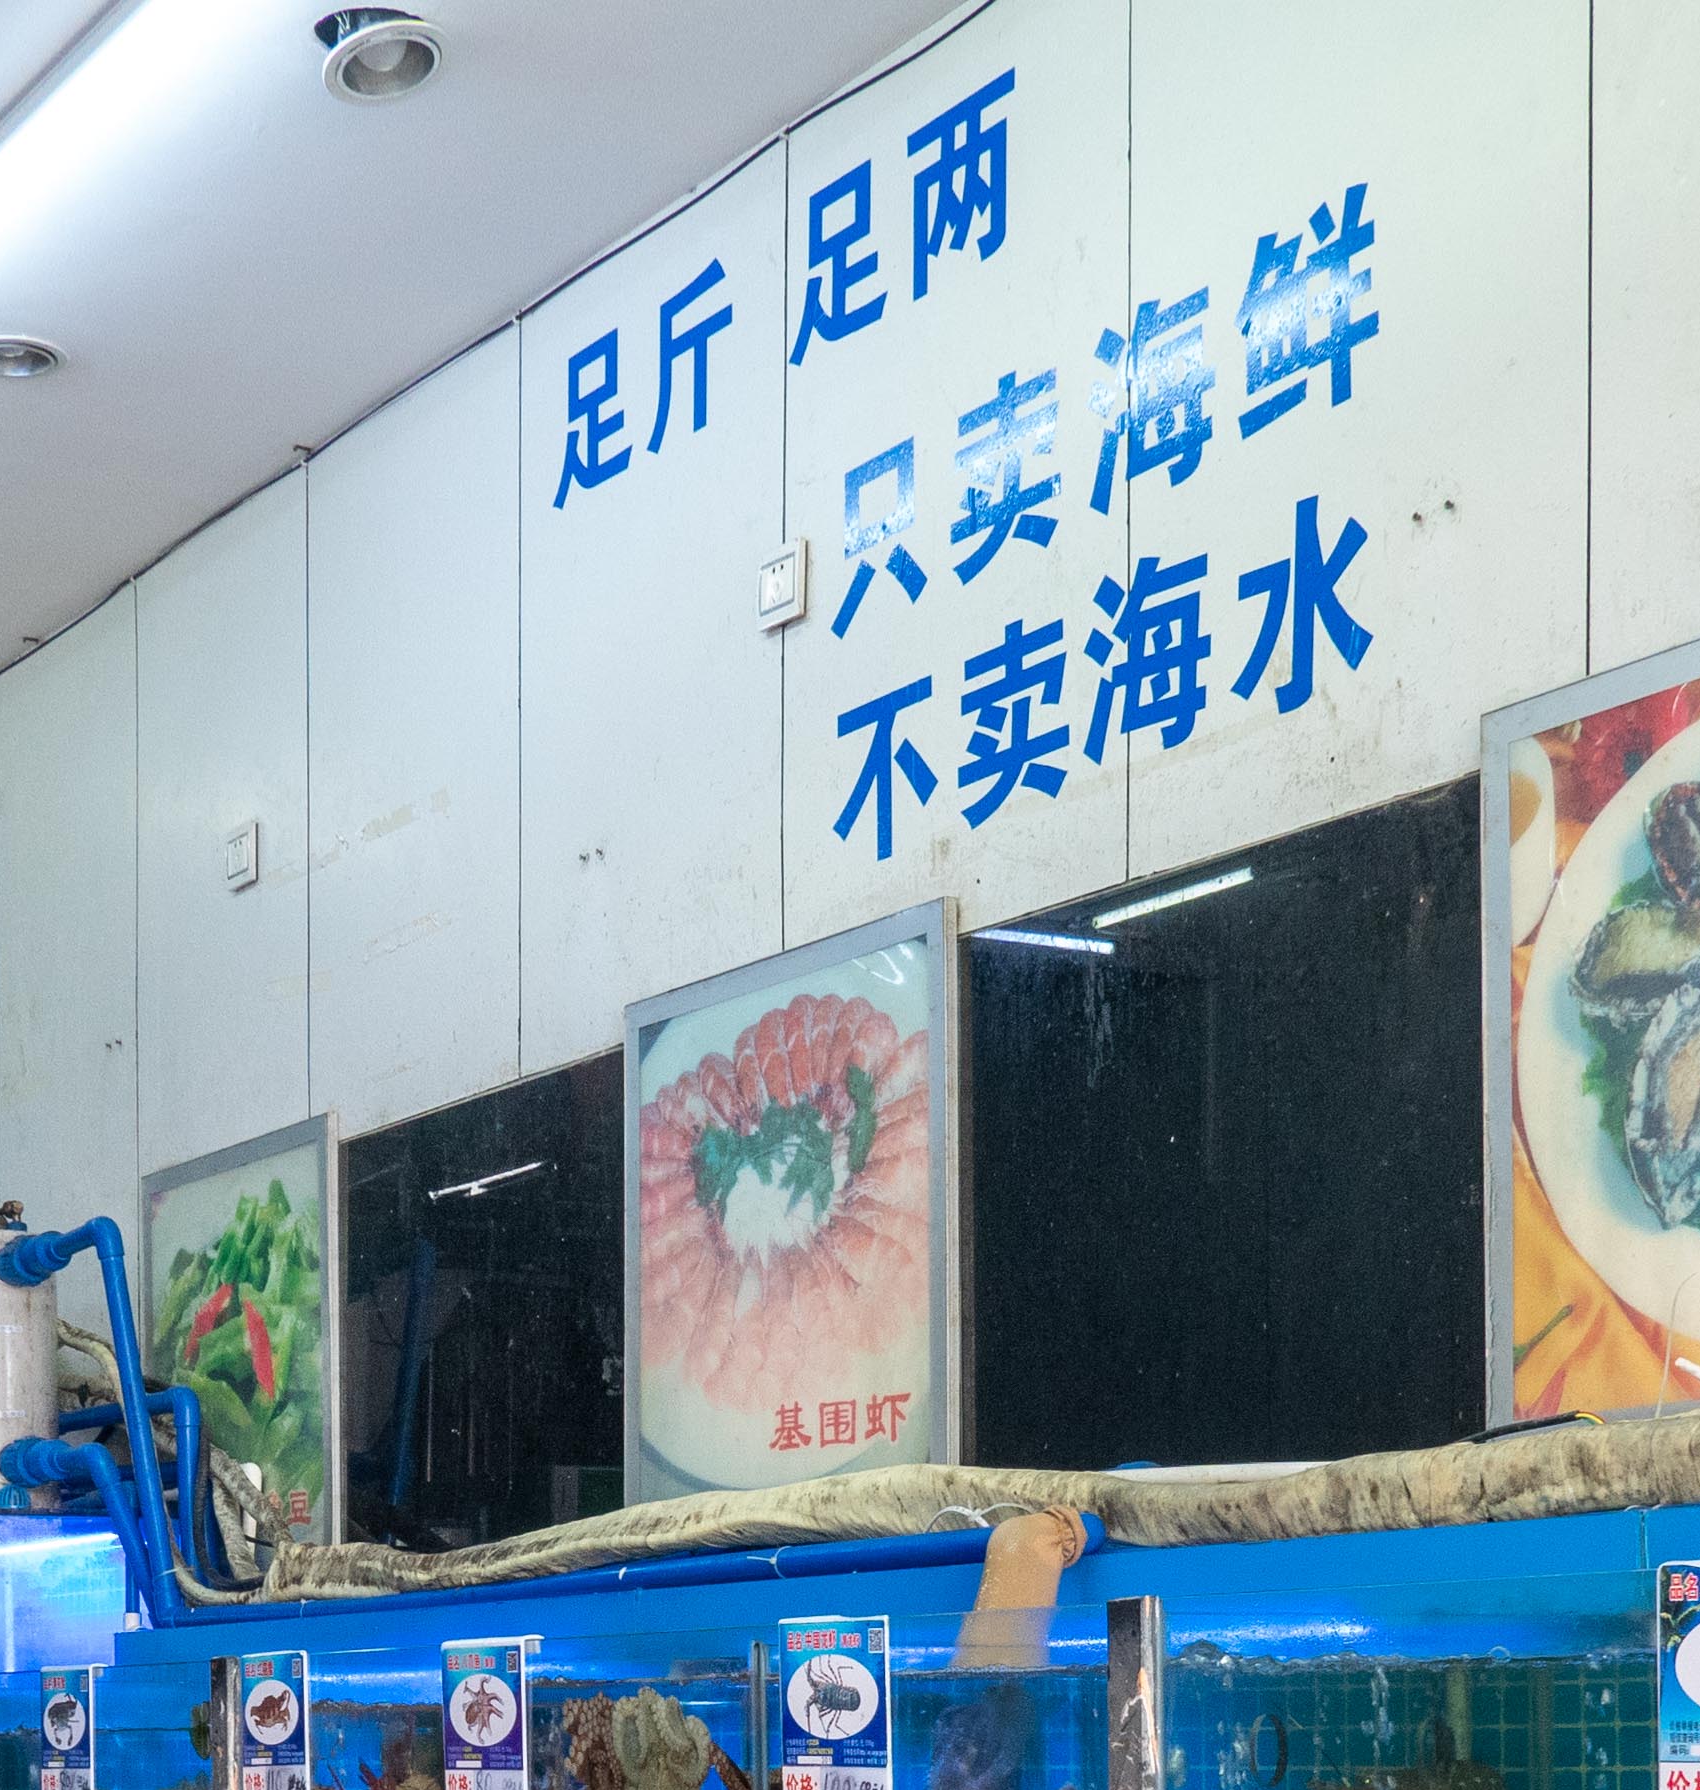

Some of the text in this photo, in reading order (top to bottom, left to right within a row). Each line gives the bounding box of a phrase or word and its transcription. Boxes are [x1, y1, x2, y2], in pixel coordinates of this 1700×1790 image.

[552, 67, 1016, 510] 足斤 足两
[830, 183, 1380, 638] 只卖海鲜
[832, 495, 1375, 862] 不卖海水
[769, 1393, 911, 1451] 基围虾
